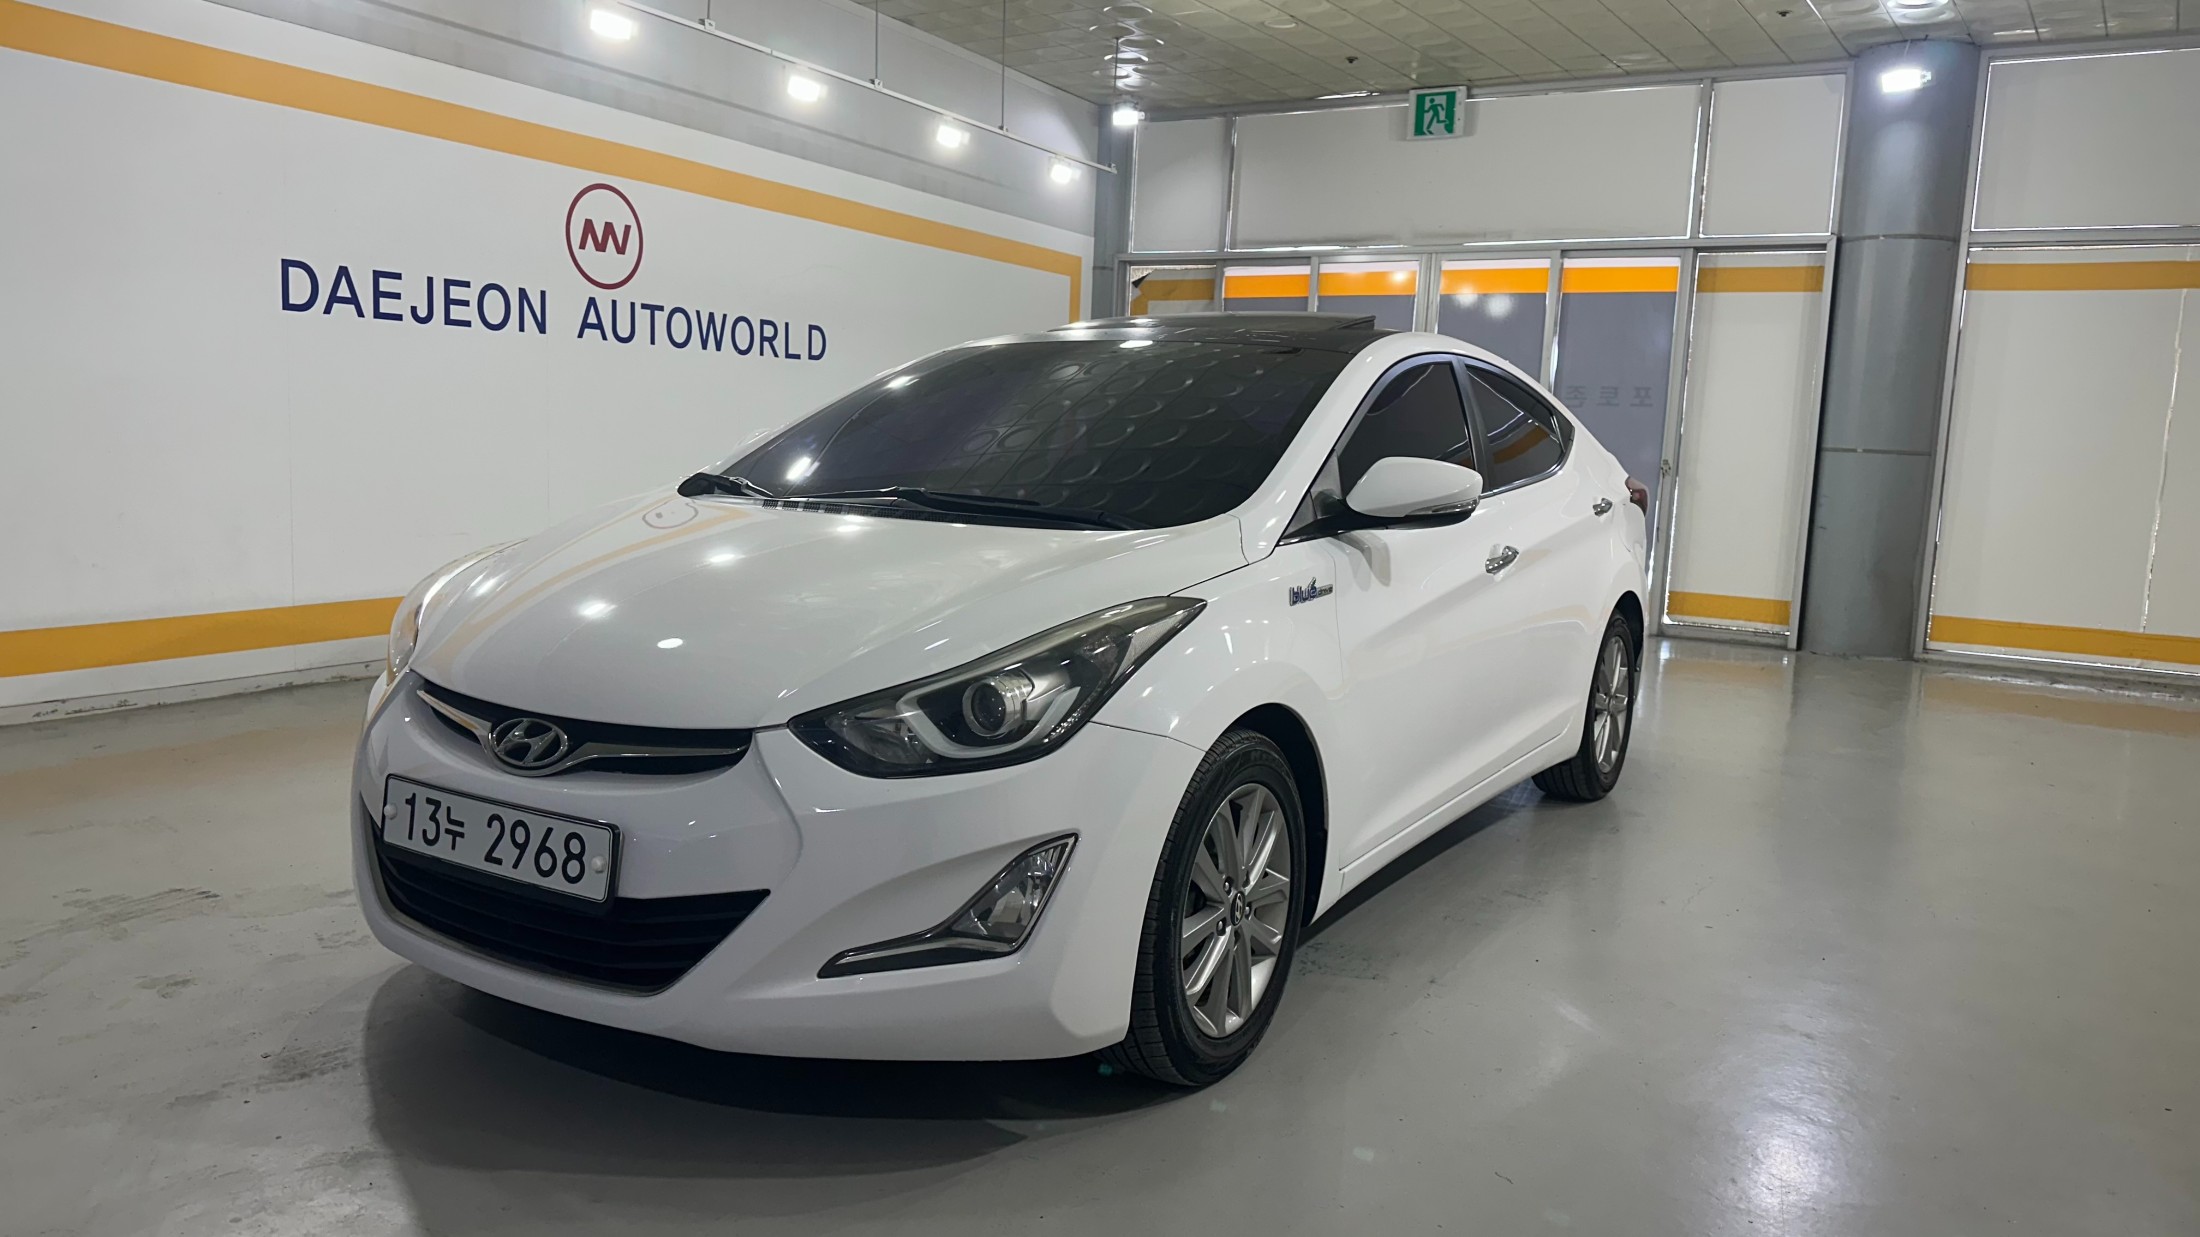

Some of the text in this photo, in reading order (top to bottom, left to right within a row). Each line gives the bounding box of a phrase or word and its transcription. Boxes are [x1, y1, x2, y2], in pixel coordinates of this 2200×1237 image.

[280, 258, 828, 360] DAEJEON AUTOWORLD
[404, 792, 586, 885] 13누 2968
